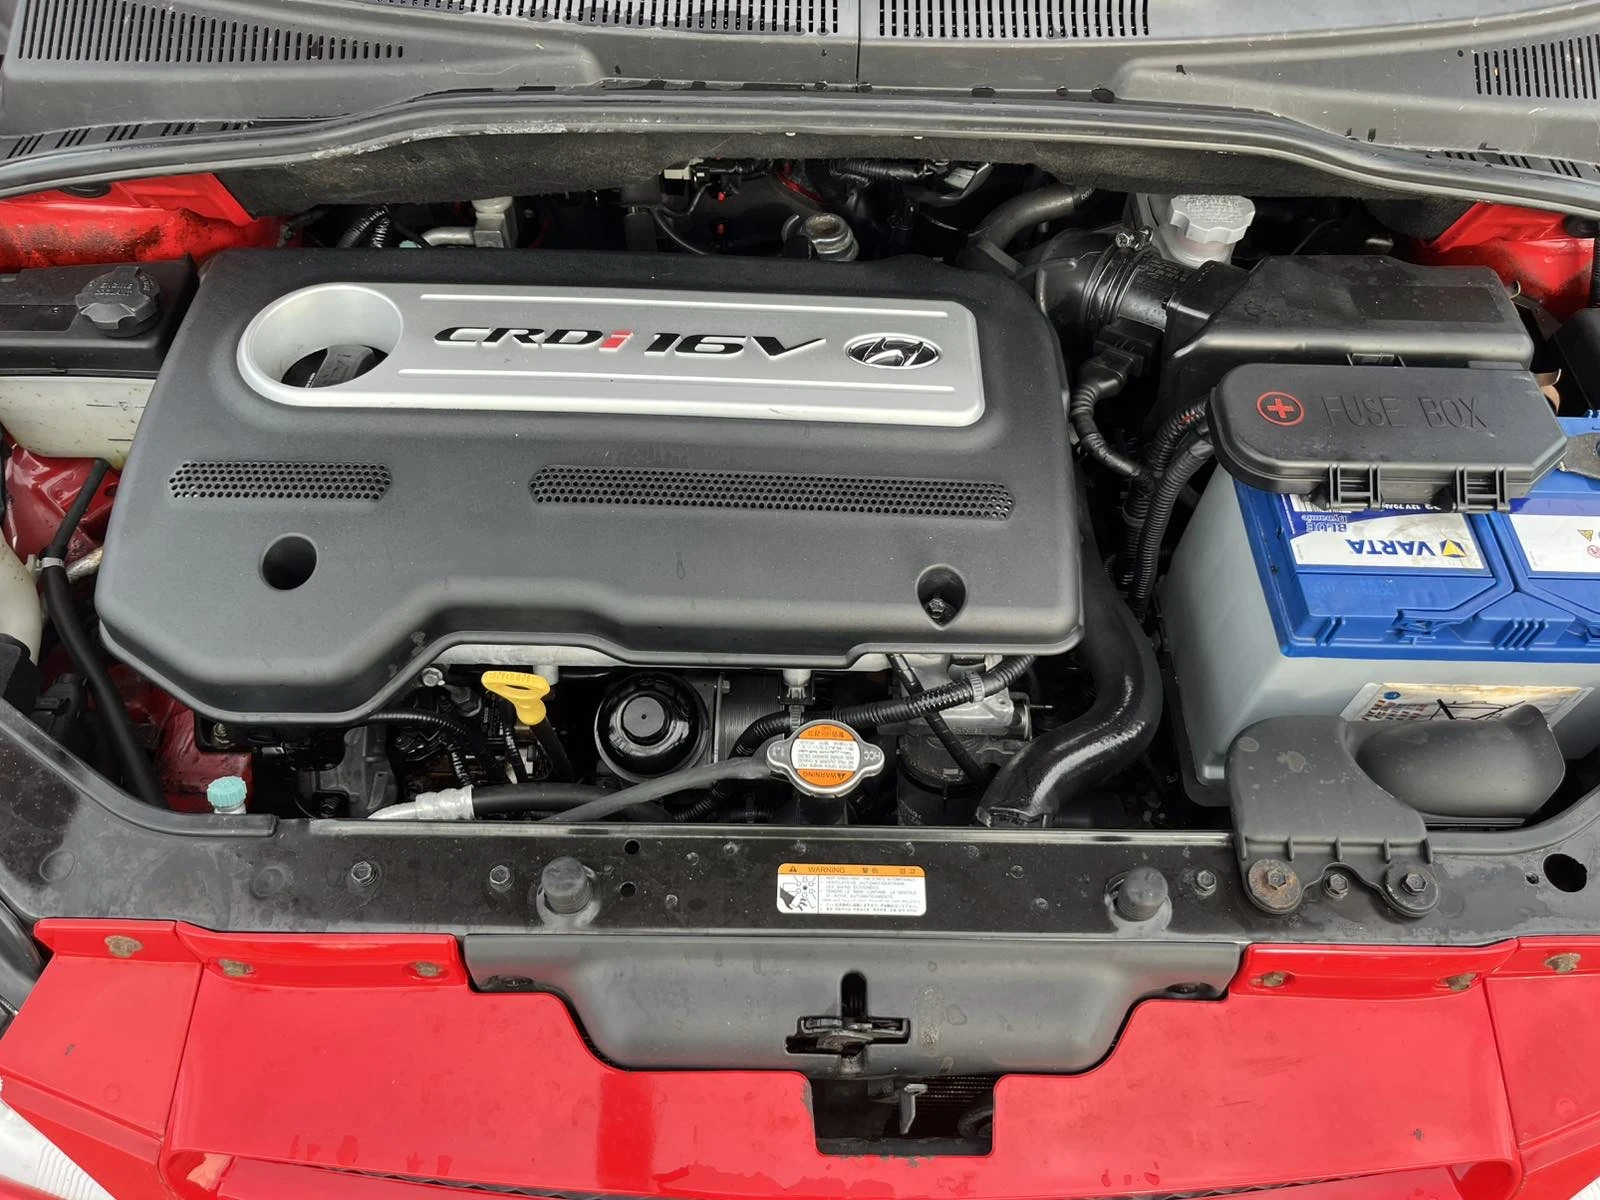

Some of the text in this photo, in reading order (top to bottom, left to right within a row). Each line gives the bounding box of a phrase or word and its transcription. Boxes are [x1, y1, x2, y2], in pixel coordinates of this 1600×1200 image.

[433, 326, 827, 361] CRDi 16V
[1320, 395, 1488, 428] FUSE BOX
[1301, 514, 1347, 524] Dynamic
[1306, 522, 1347, 533] BLUE
[1345, 539, 1436, 556] VARTA
[863, 751, 881, 760] HCC
[802, 771, 837, 779] WARNING
[807, 866, 846, 874] WARNING
